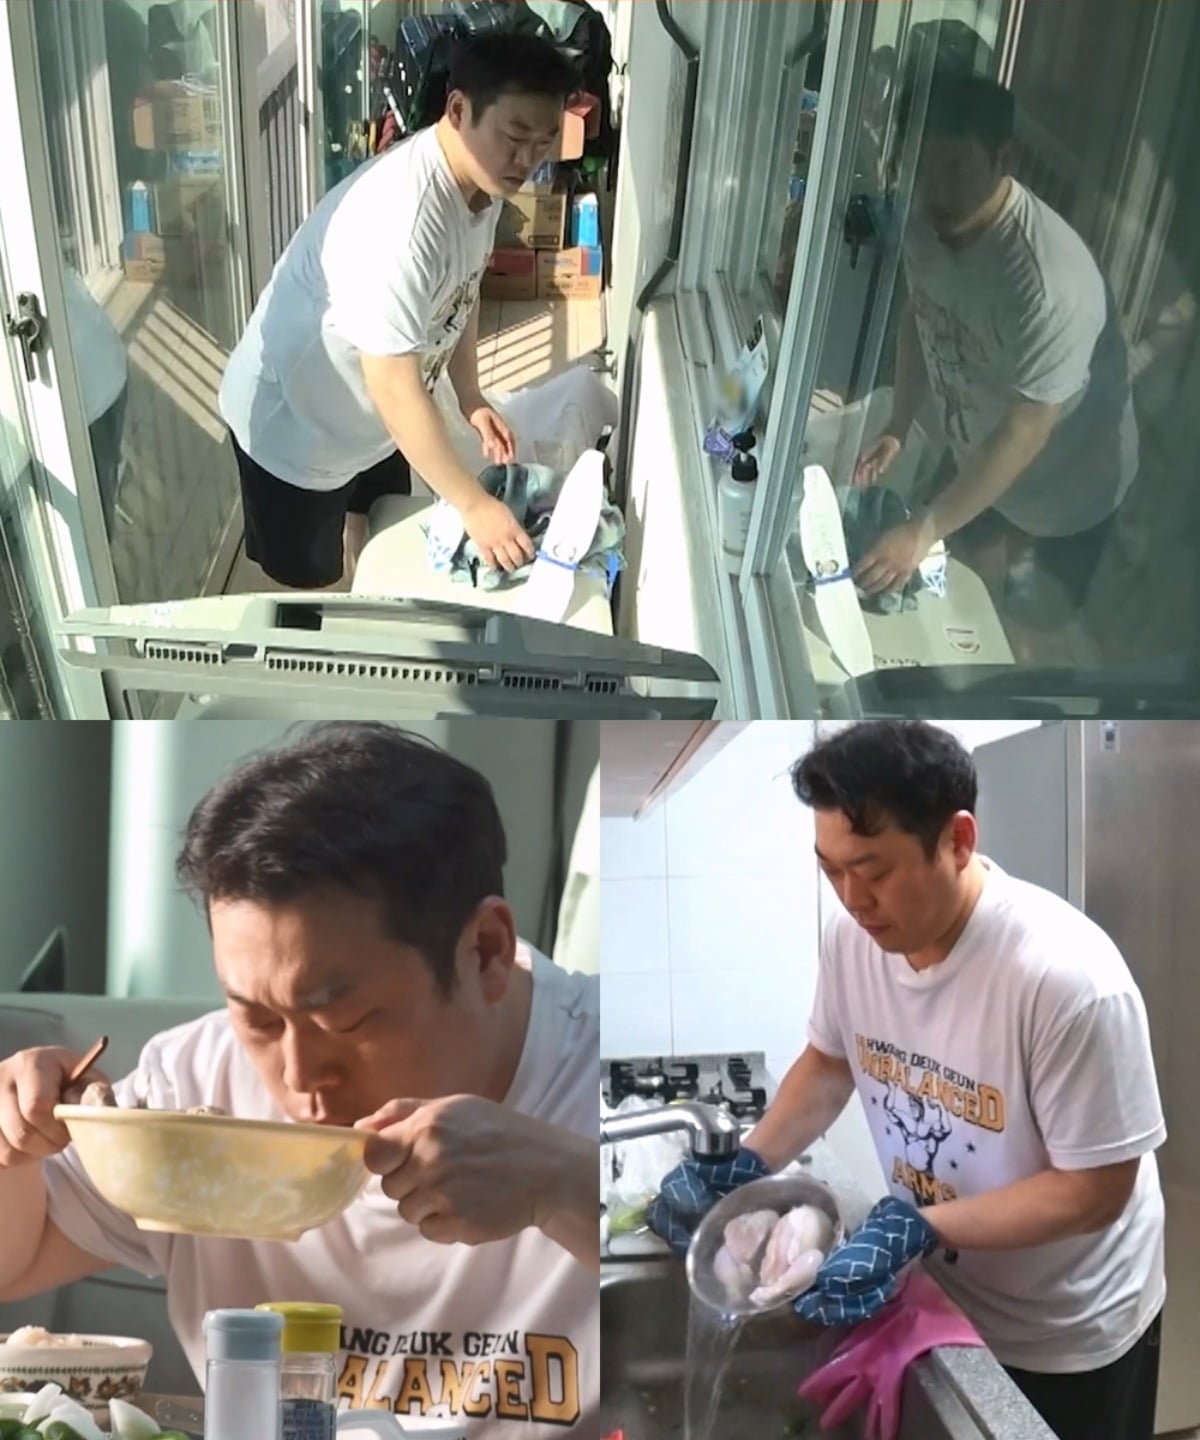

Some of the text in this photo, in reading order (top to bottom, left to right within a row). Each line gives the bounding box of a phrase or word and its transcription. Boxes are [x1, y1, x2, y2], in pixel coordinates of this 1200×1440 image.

[866, 1037, 977, 1092] HWANG DEUK GEUN
[339, 1324, 391, 1356] ANG
[337, 1332, 581, 1427] ALANCED
